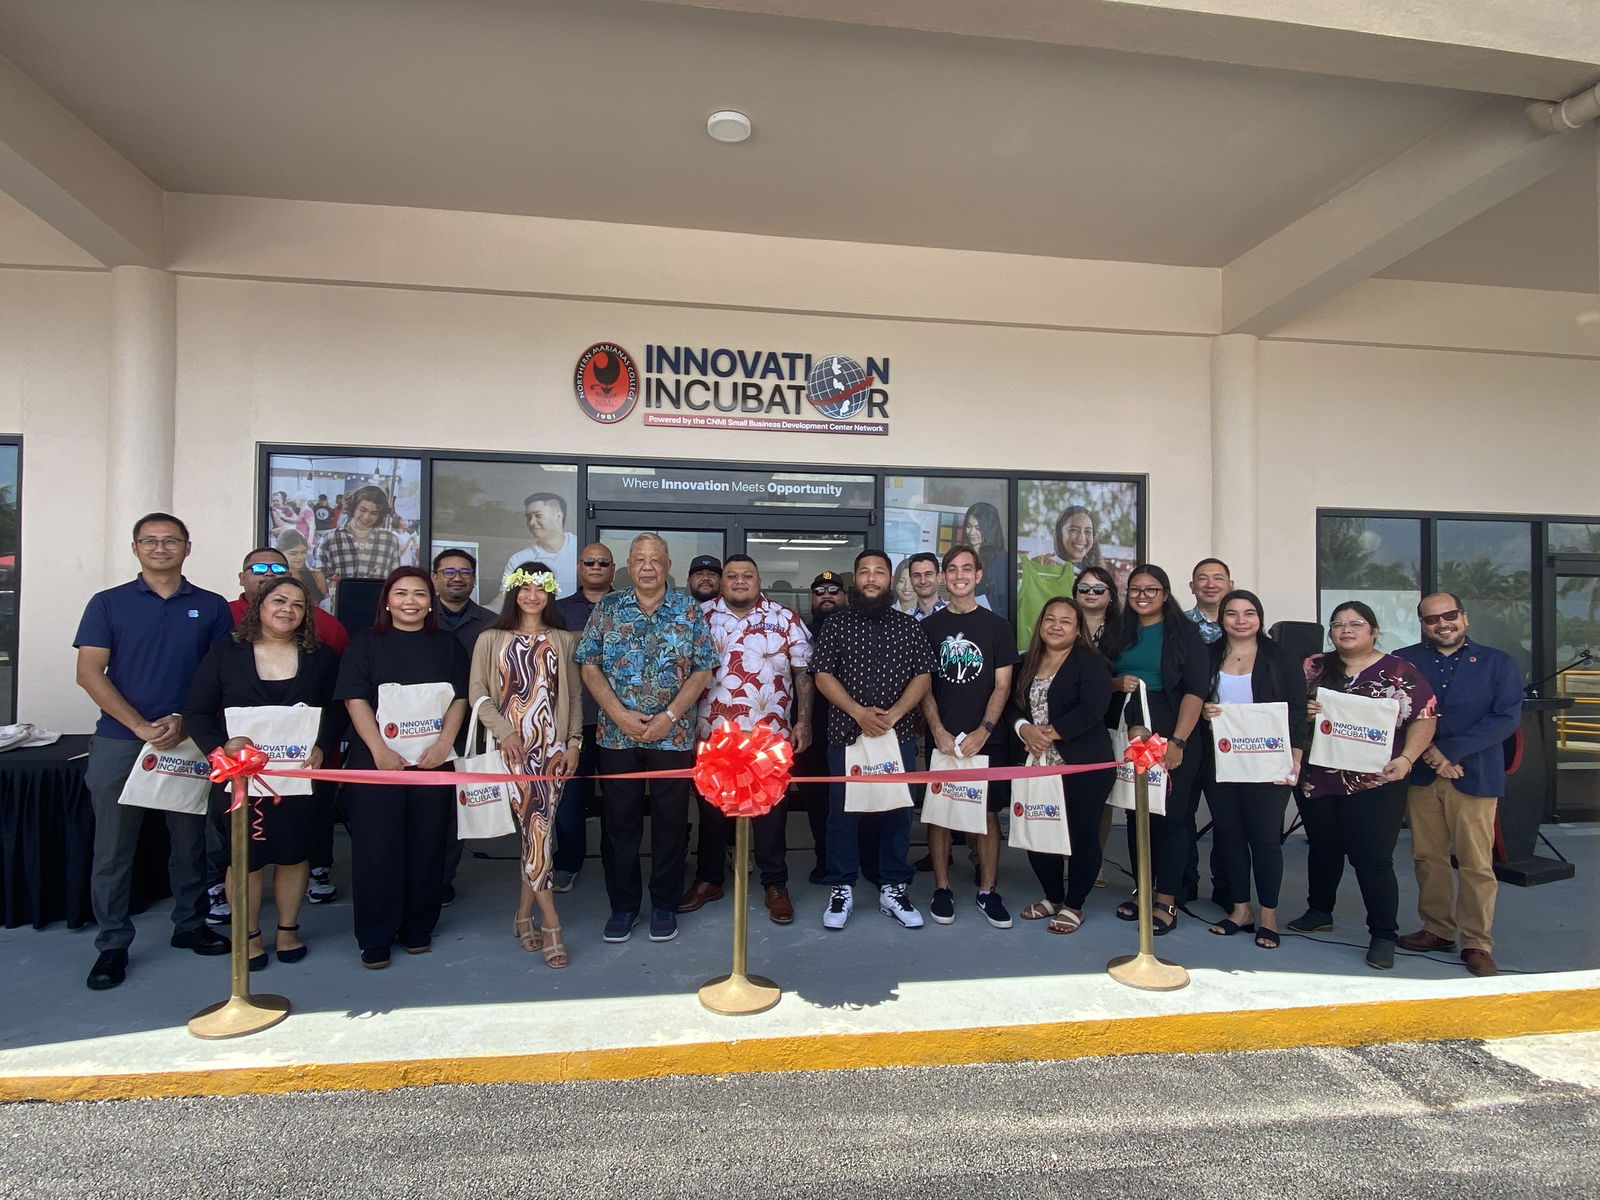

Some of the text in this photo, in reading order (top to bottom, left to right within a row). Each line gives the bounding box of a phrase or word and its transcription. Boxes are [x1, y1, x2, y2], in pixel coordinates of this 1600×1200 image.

[577, 352, 592, 399] NORTHERN
[592, 345, 631, 366] MARIANAS
[596, 412, 616, 421] 1981
[648, 415, 883, 432] Powered by the CNMI Small Business Development Center Network
[622, 477, 842, 497] Where Innovation Meets Opportunity
